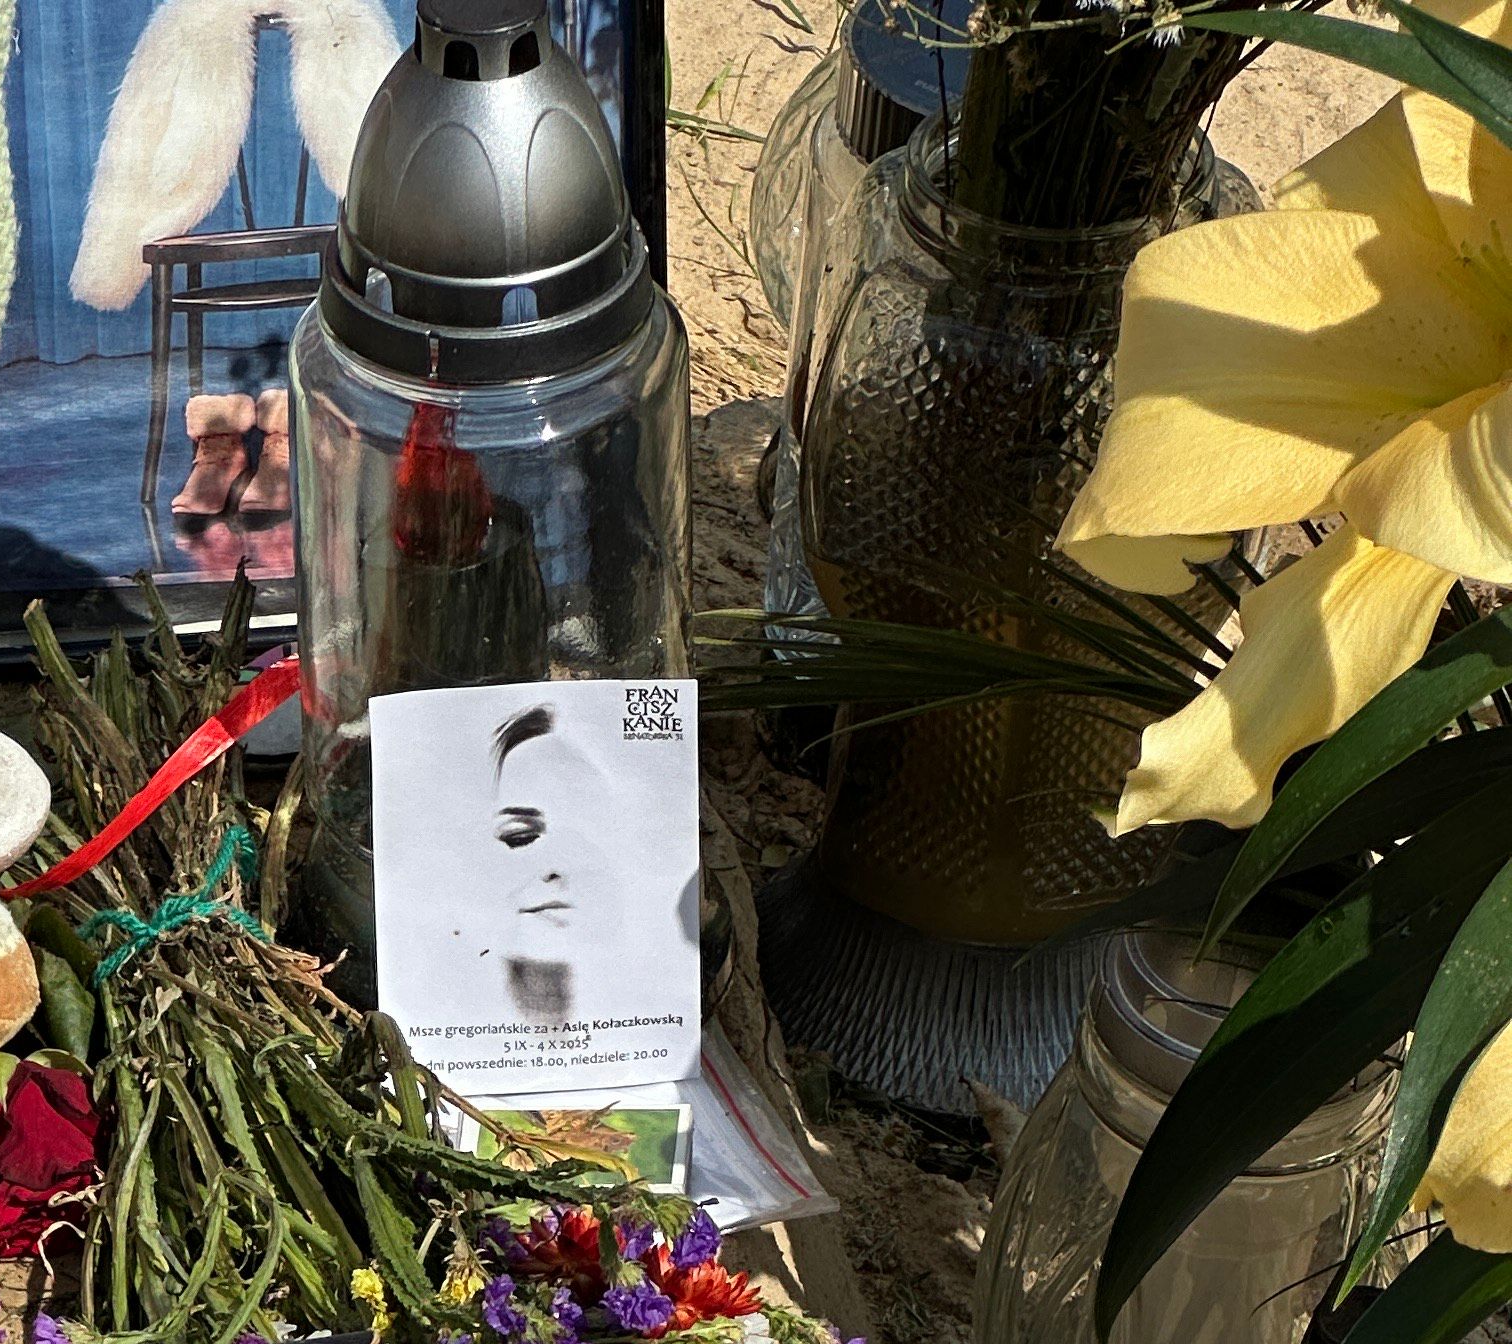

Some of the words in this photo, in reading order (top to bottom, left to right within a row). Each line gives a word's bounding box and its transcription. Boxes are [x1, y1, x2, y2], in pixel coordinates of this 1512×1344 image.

[625, 685, 679, 703] FRAN
[628, 702, 674, 716] CISZ
[623, 715, 682, 732] KANIE
[409, 1026, 442, 1037] Msze
[446, 1024, 531, 1039] gregoriańskie
[534, 1026, 548, 1034] za
[562, 1022, 589, 1034] Asię
[593, 1014, 684, 1030] Kołaczkowską
[504, 1042, 510, 1052] 5
[515, 1040, 526, 1051] IX
[538, 1042, 544, 1052] 4
[548, 1040, 557, 1050] X
[560, 1037, 589, 1049] 2025
[448, 1058, 527, 1073] powszednie:
[530, 1057, 568, 1068] 18.00,
[571, 1051, 630, 1065] niedziele:
[634, 1048, 668, 1060] 20.00
